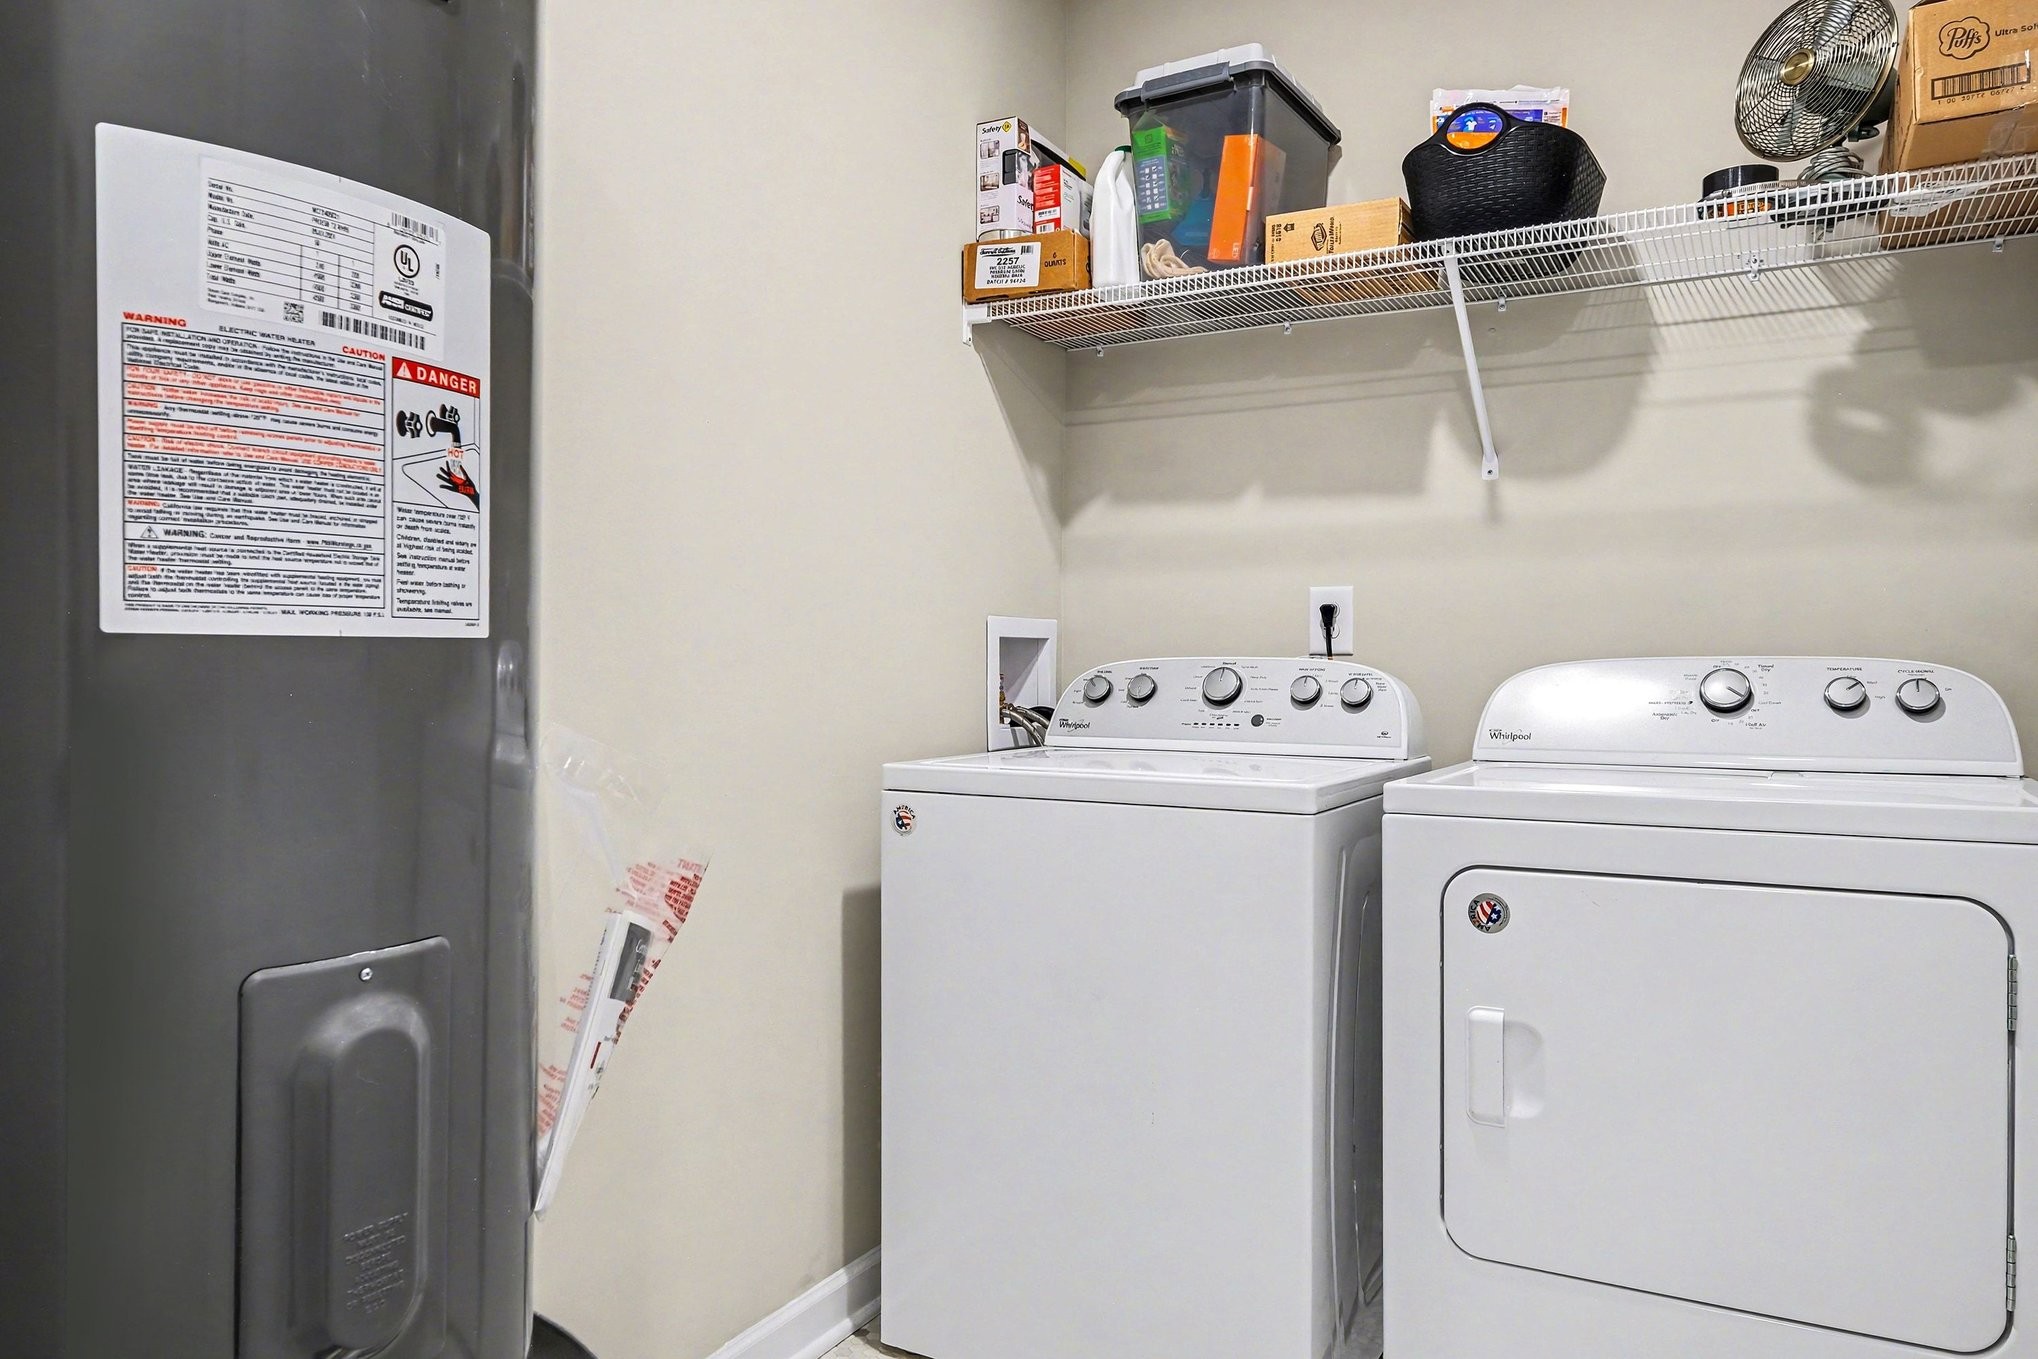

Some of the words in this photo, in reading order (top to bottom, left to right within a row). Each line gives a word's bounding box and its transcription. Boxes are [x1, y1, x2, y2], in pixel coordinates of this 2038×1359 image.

[1947, 26, 1982, 52] Puffs
[1995, 28, 2018, 37] Ultra
[982, 125, 1002, 134] Safety
[400, 250, 414, 272] UL
[997, 257, 1020, 266] 2257
[1044, 259, 1066, 268] QUARTS
[123, 312, 187, 328] WARNING
[218, 325, 257, 337] ELECTRIC
[259, 331, 285, 341] WATER
[287, 336, 316, 346] HEATER
[342, 346, 386, 360] CAUTION
[416, 366, 477, 394] DANGER
[448, 448, 464, 459] HOT
[163, 528, 207, 538] WARNING:
[1059, 721, 1090, 730] Whirlpool
[1490, 732, 1532, 742] Whirlpool
